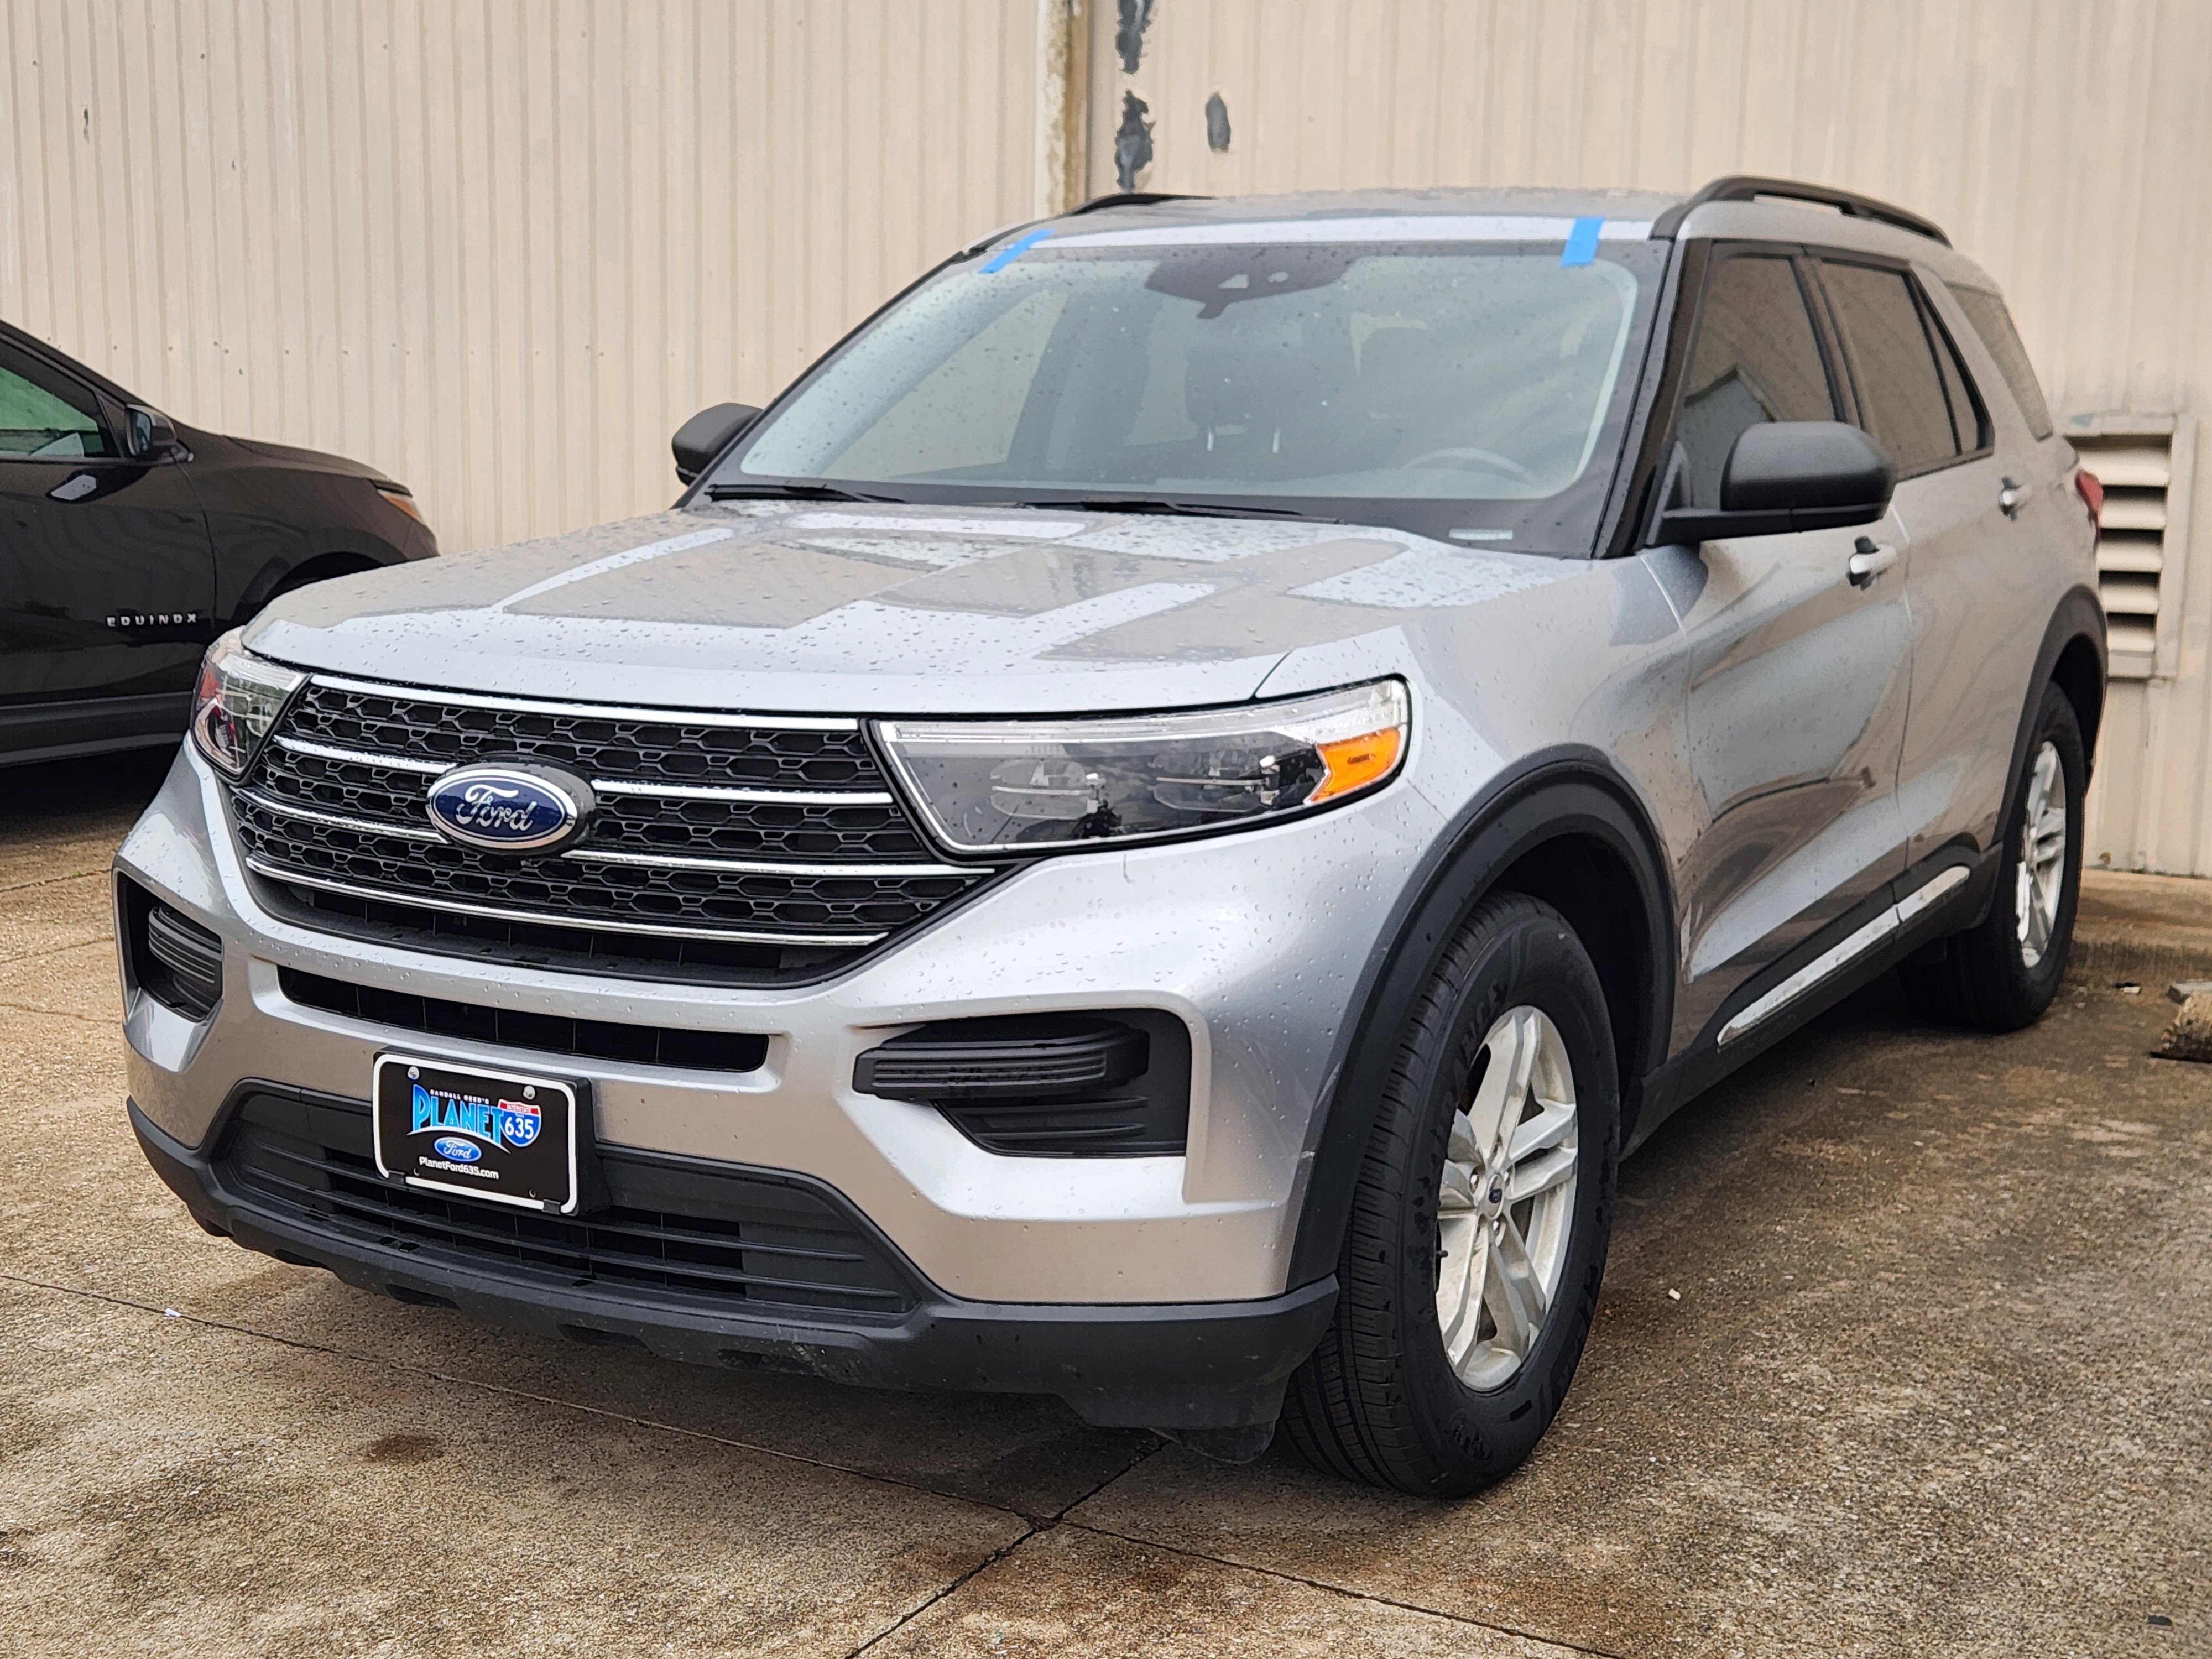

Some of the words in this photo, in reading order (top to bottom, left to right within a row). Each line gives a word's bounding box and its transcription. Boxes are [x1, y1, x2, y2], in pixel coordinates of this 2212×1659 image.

[107, 613, 196, 627] EQUINOX
[456, 784, 538, 831] Ford
[413, 1084, 504, 1145] PLANET
[505, 1117, 534, 1140] 635
[443, 1140, 472, 1159] Ford
[419, 1156, 499, 1180] PlanetFord635.com
